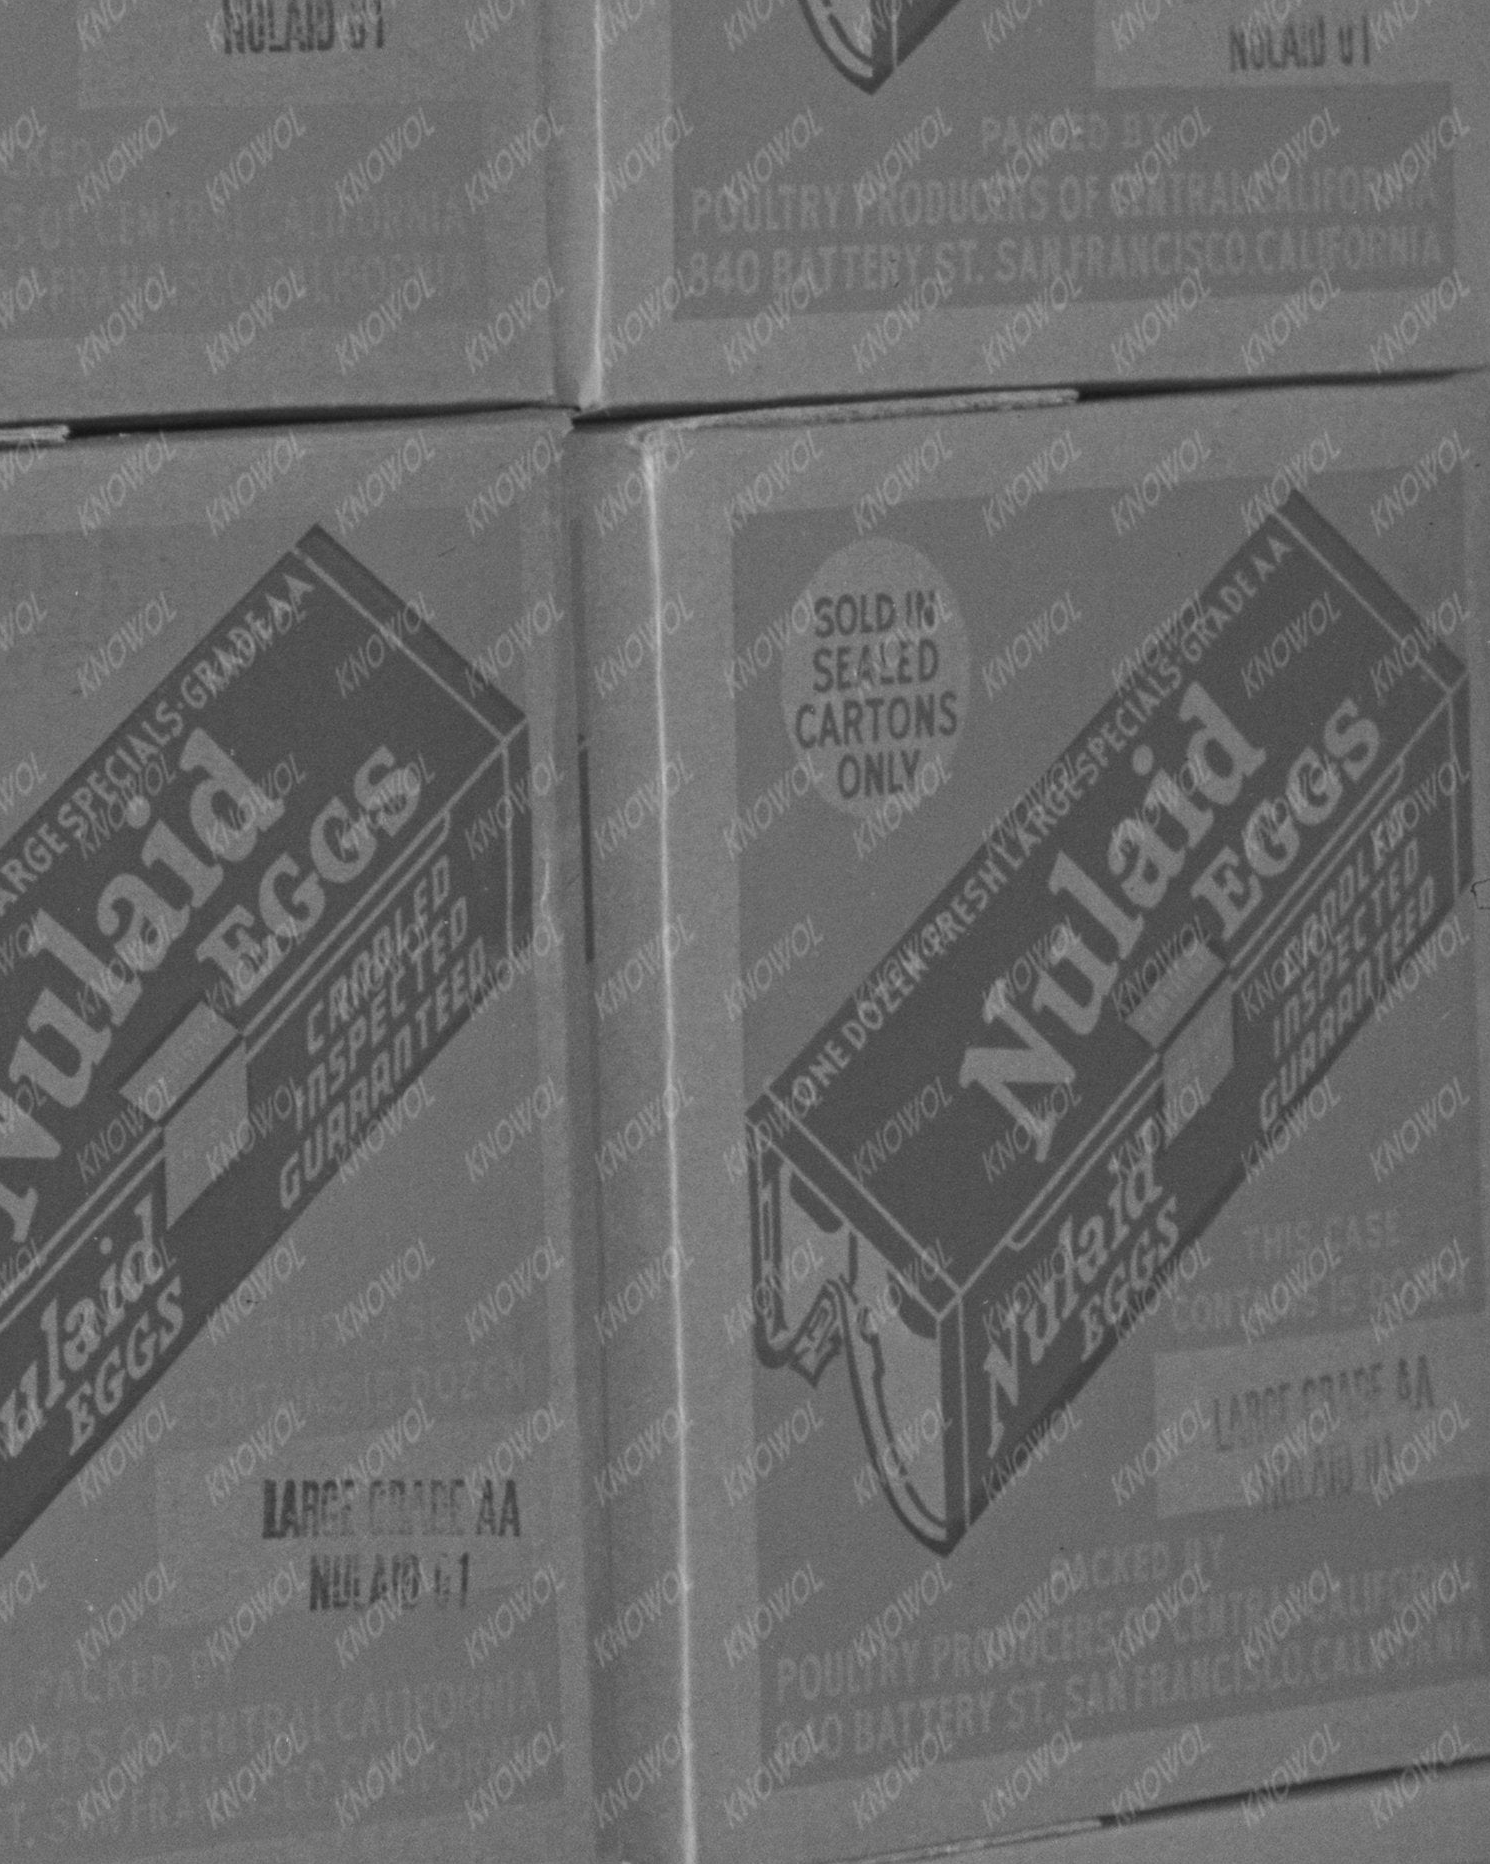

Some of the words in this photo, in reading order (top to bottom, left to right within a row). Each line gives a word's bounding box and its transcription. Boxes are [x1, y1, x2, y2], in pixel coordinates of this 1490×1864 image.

[811, 639, 940, 693] SEALED
[812, 593, 897, 637] SOLD
[905, 589, 935, 628] IN
[794, 691, 960, 749] CARTONS
[835, 749, 920, 799] ONLY
[198, 748, 420, 1004] EGGS
[1190, 699, 1381, 941] EGGS
[959, 681, 1265, 1162] Nulaid
[69, 1277, 186, 1454] EGGS
[983, 1115, 1164, 1457] Nulaid
[1082, 1195, 1179, 1364] EGGS
